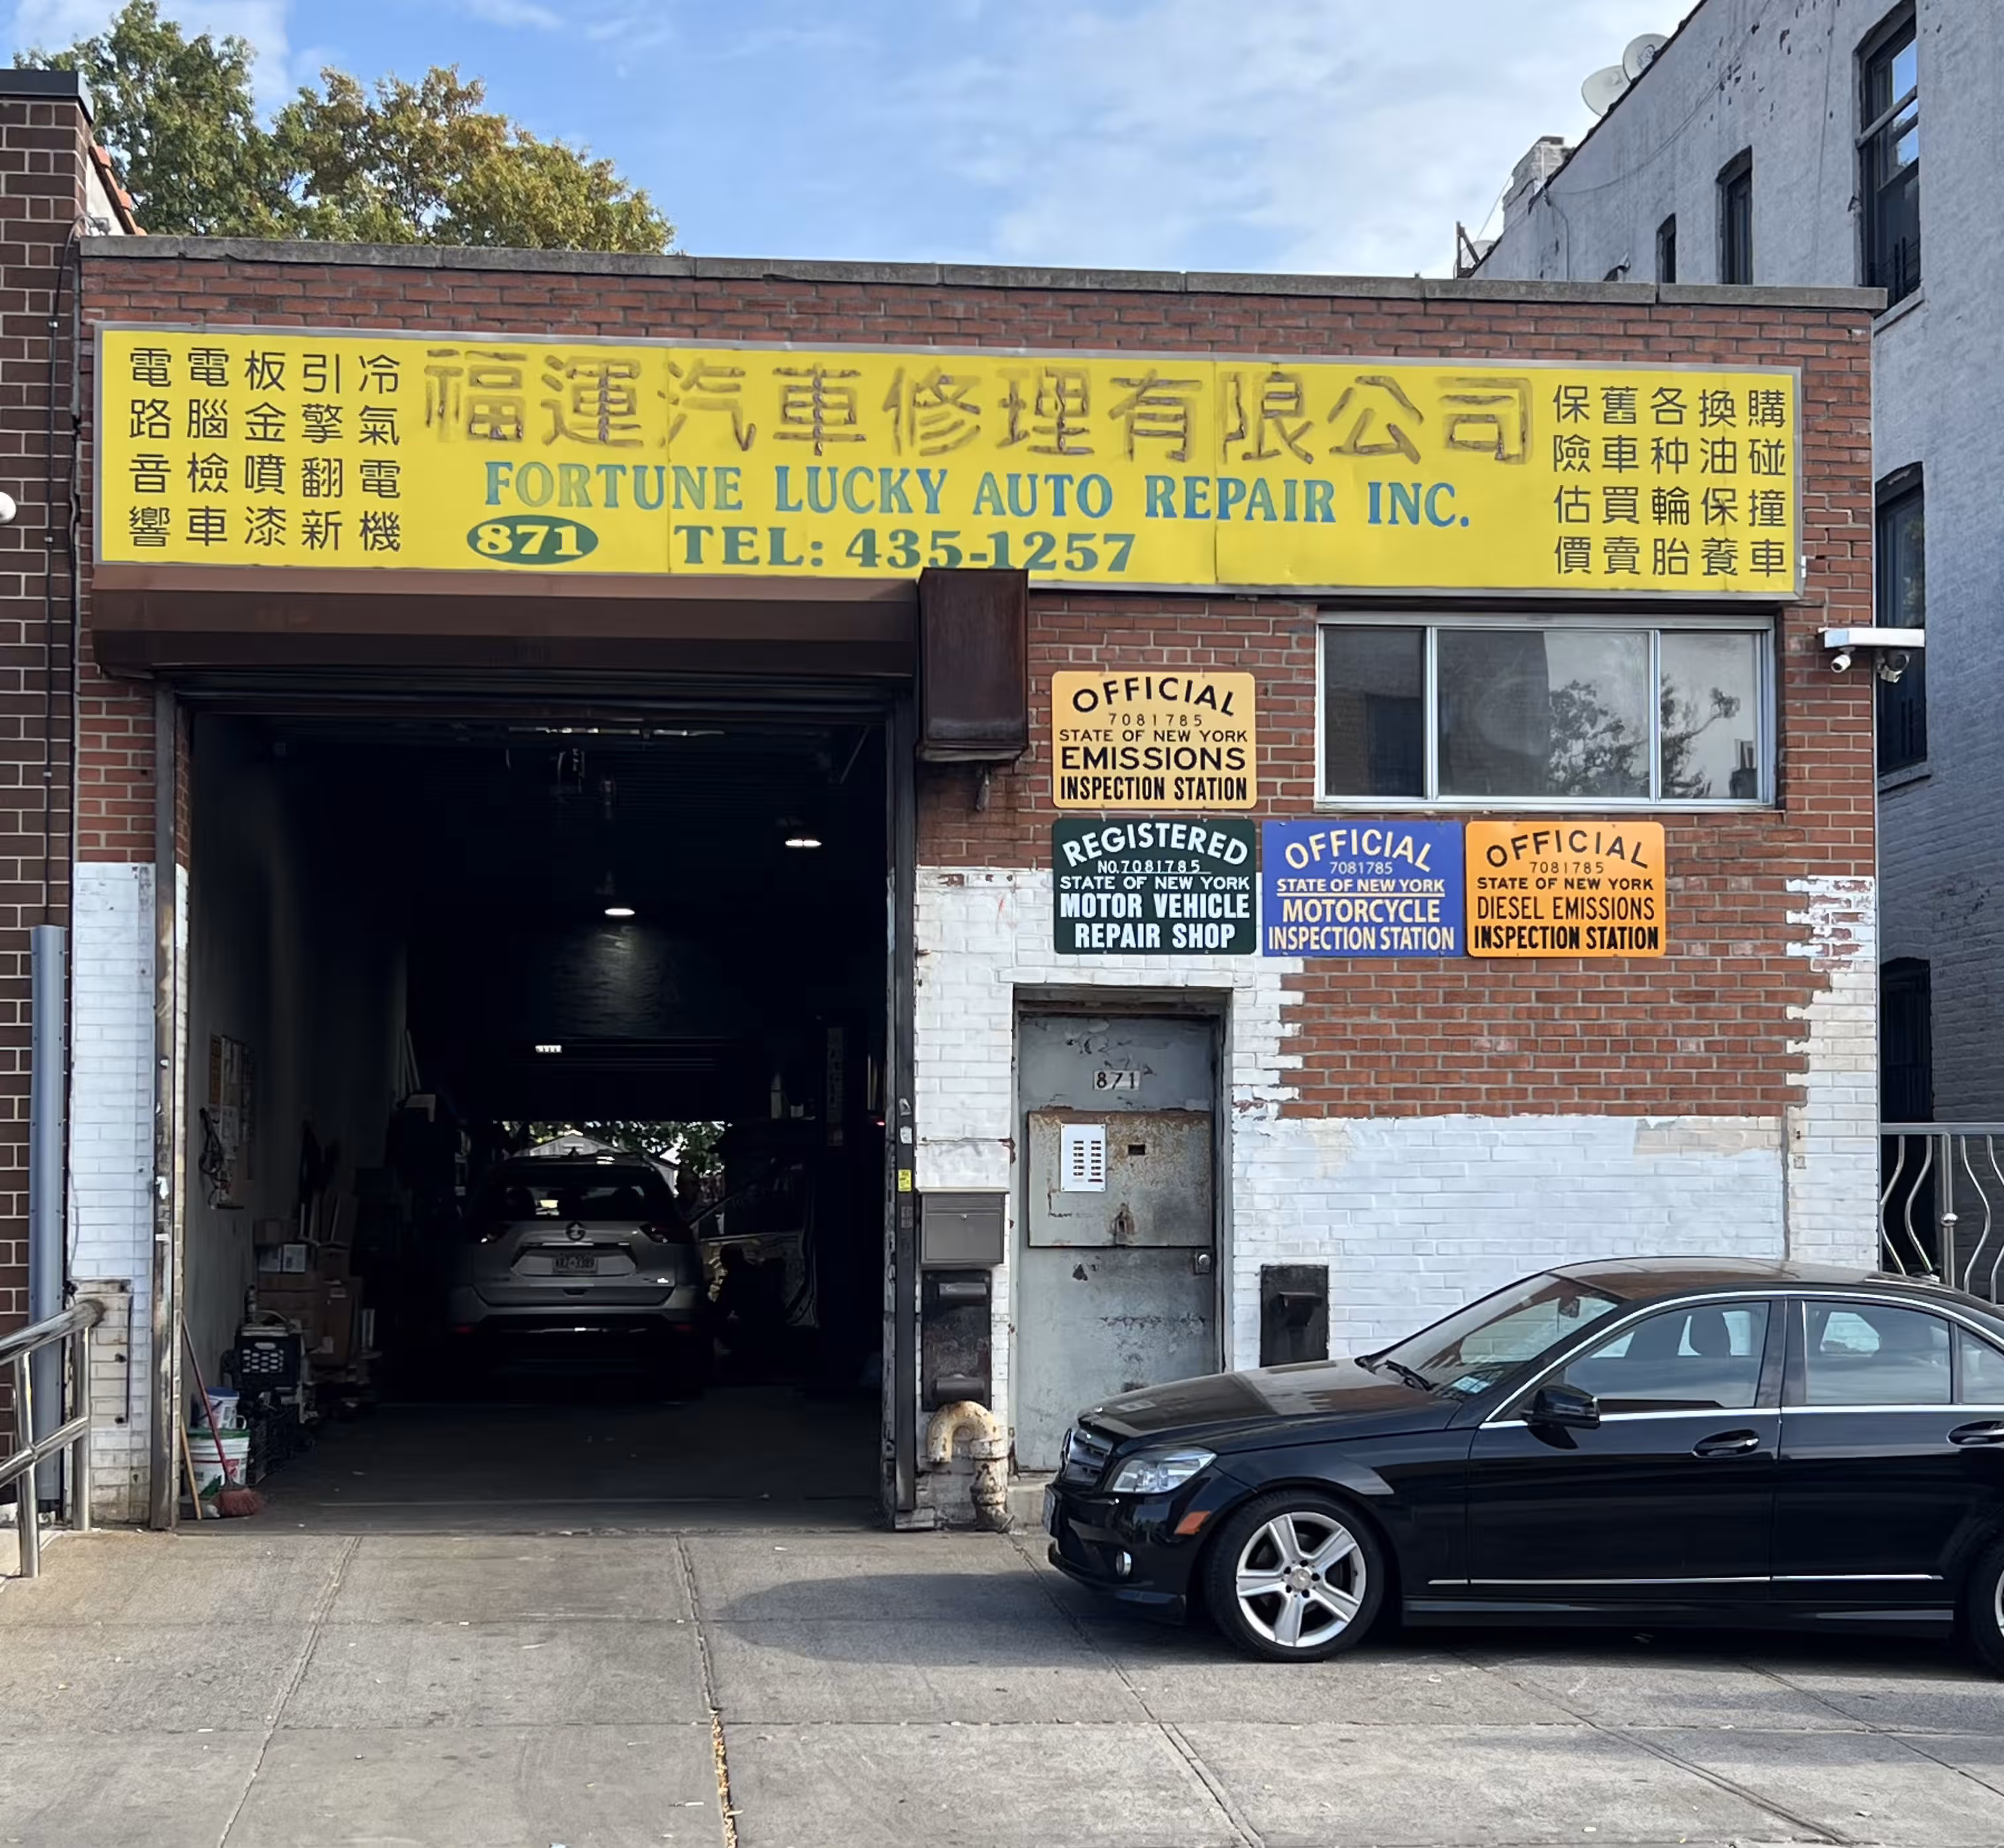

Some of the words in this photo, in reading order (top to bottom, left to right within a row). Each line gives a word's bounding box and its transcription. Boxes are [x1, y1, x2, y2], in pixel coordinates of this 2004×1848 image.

[424, 348, 1533, 464] 福運汽車修理有限公司
[129, 347, 172, 548] 電路音響
[186, 347, 229, 547] 電腦檢車
[244, 350, 286, 548] 板金噴漆
[302, 353, 343, 551] 引擎翻新
[359, 354, 401, 553] 冷氣電機
[1553, 384, 1591, 574] 保險估價
[1600, 386, 1640, 575] 舊車買賣
[1698, 389, 1738, 575] 換油保養
[484, 461, 743, 510] FORTUNE
[774, 466, 948, 515] LUCKY
[972, 472, 1113, 518] AUTO
[1145, 475, 1337, 522] REPAIR
[1368, 481, 1470, 527] INC.
[475, 524, 583, 557] 871
[674, 525, 824, 567] TEL:
[845, 528, 1135, 573] 435-1257
[1072, 676, 1235, 717] OFFICIAL
[1108, 713, 1202, 726] 7081785
[1060, 730, 1113, 742] STATE
[1122, 730, 1144, 742] OF
[1154, 730, 1191, 742] NEW
[1199, 730, 1247, 742] YORK
[1062, 746, 1246, 770] EMISSIONS
[1061, 776, 1164, 800] INSPECTION
[1174, 777, 1247, 801] STATION
[1062, 823, 1248, 867] REGISTERED
[1285, 828, 1431, 872] OFFICIAL
[1486, 829, 1648, 869] OFFICIAL
[1330, 862, 1393, 875] 7081785
[1530, 862, 1604, 874] 7081785
[1060, 876, 1115, 890] STATE
[1123, 876, 1147, 890] OF
[1155, 876, 1192, 890] NEW
[1200, 876, 1250, 890] YORK
[1277, 879, 1326, 892] STATE
[1330, 879, 1353, 892] OF
[1358, 879, 1394, 892] NEW
[1398, 879, 1445, 892] YORK
[1478, 877, 1529, 890] STATE
[1535, 877, 1557, 890] OF
[1565, 877, 1601, 890] NEW
[1608, 877, 1654, 890] YORK
[1060, 893, 1142, 918] MOTOR
[1154, 893, 1250, 919] VEHICLE
[1283, 899, 1440, 923] MOTORCYCLE
[1478, 896, 1544, 920] DIESEL
[1553, 896, 1655, 920] EMISSIONS
[1075, 923, 1160, 949] REPAIR
[1172, 923, 1235, 949] SHOP
[1268, 927, 1378, 951] INSPECTION
[1380, 927, 1454, 951] STATION
[1474, 926, 1580, 949] INSPECTION
[1586, 926, 1659, 950] STATION
[1095, 1072, 1137, 1089] 871
